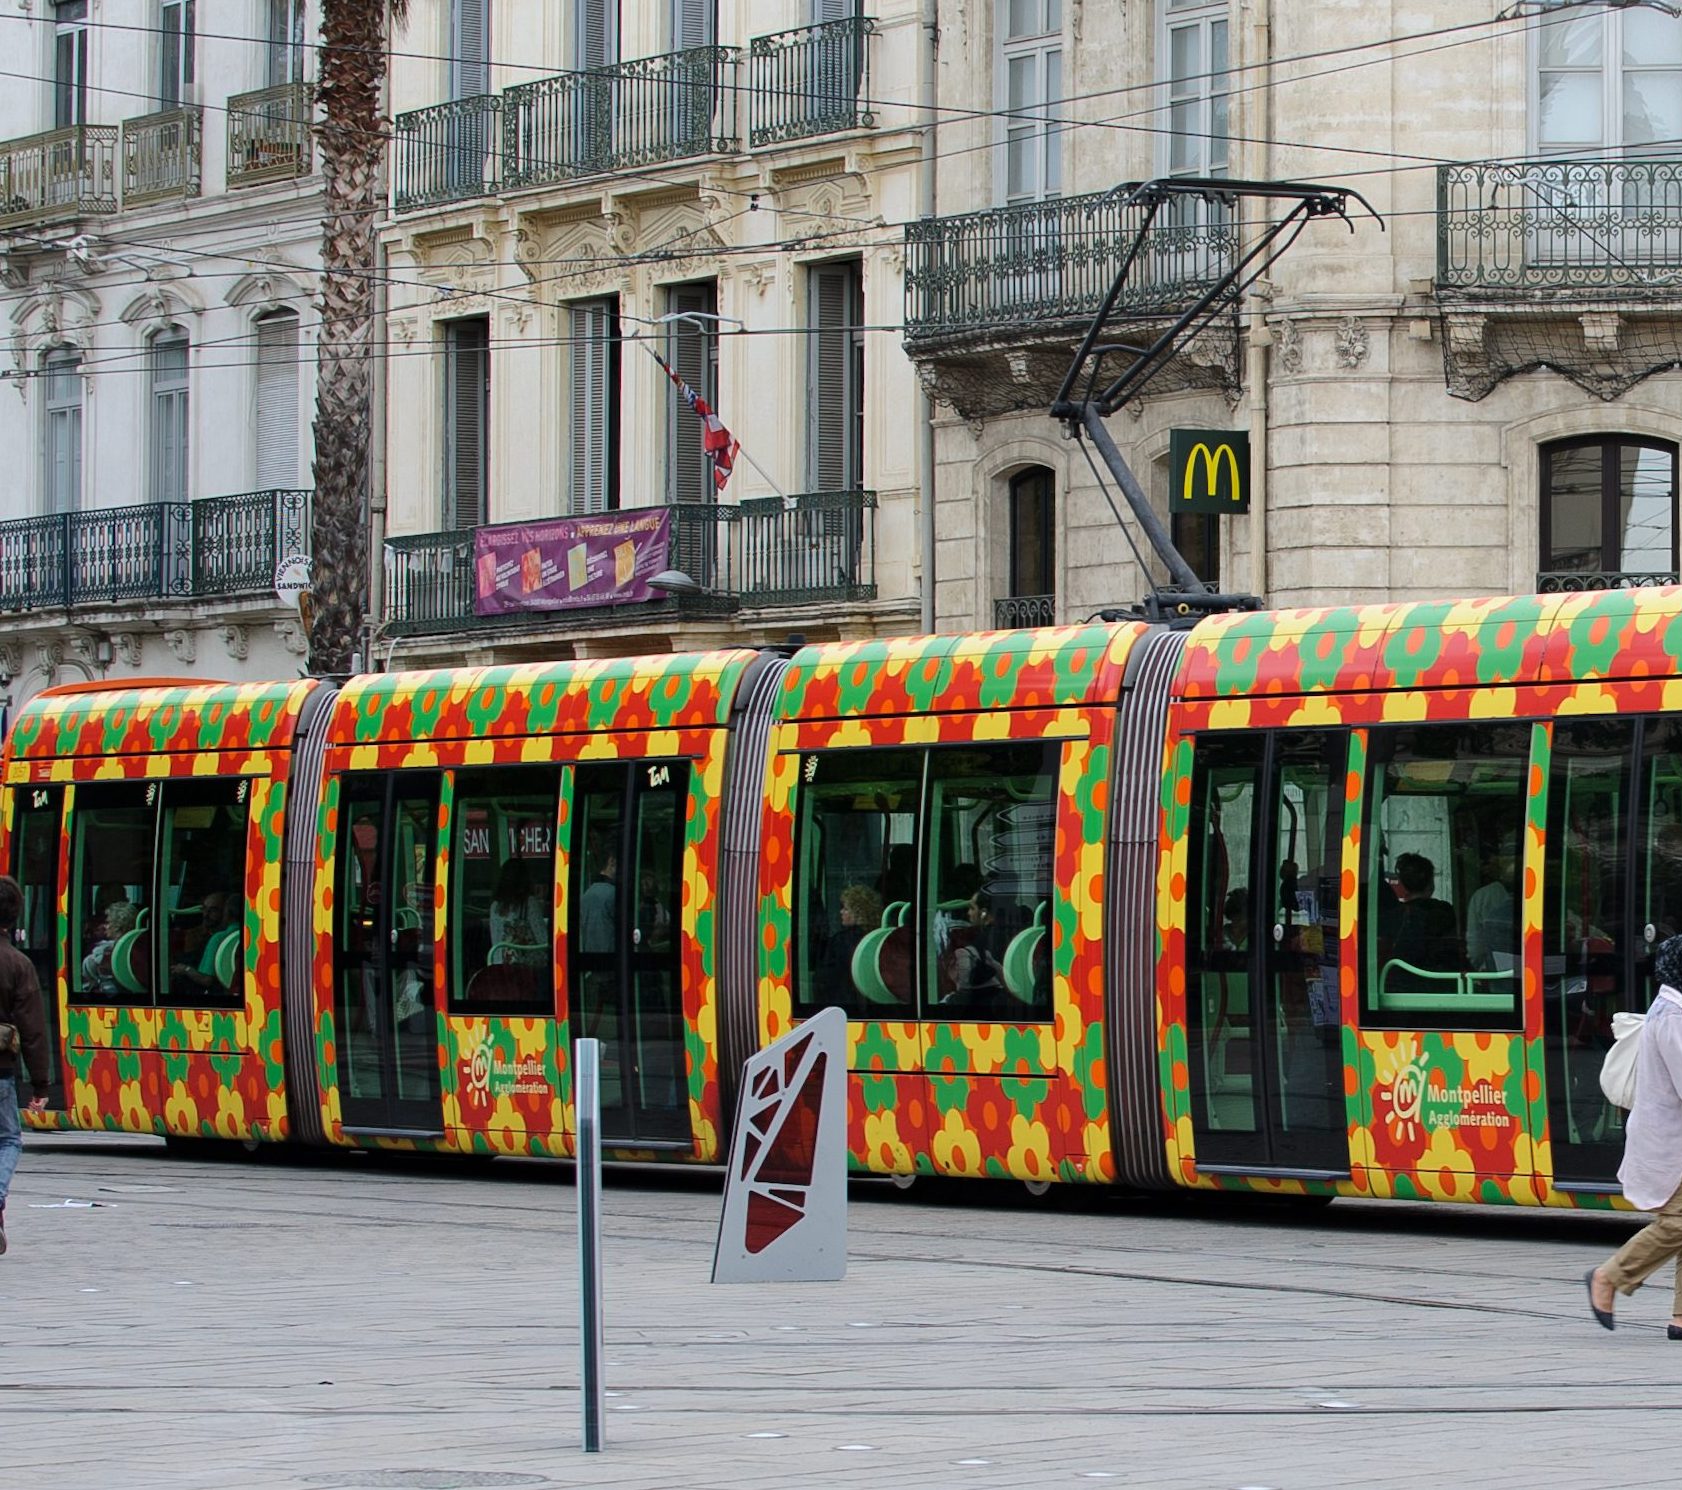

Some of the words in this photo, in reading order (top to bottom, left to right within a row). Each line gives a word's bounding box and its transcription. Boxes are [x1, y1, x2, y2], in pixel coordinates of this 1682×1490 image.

[493, 1059, 546, 1080] Montpellier
[494, 1080, 549, 1097] Agglomération
[1427, 1084, 1508, 1109] Montpellier
[1428, 1110, 1510, 1129] Agglomération
